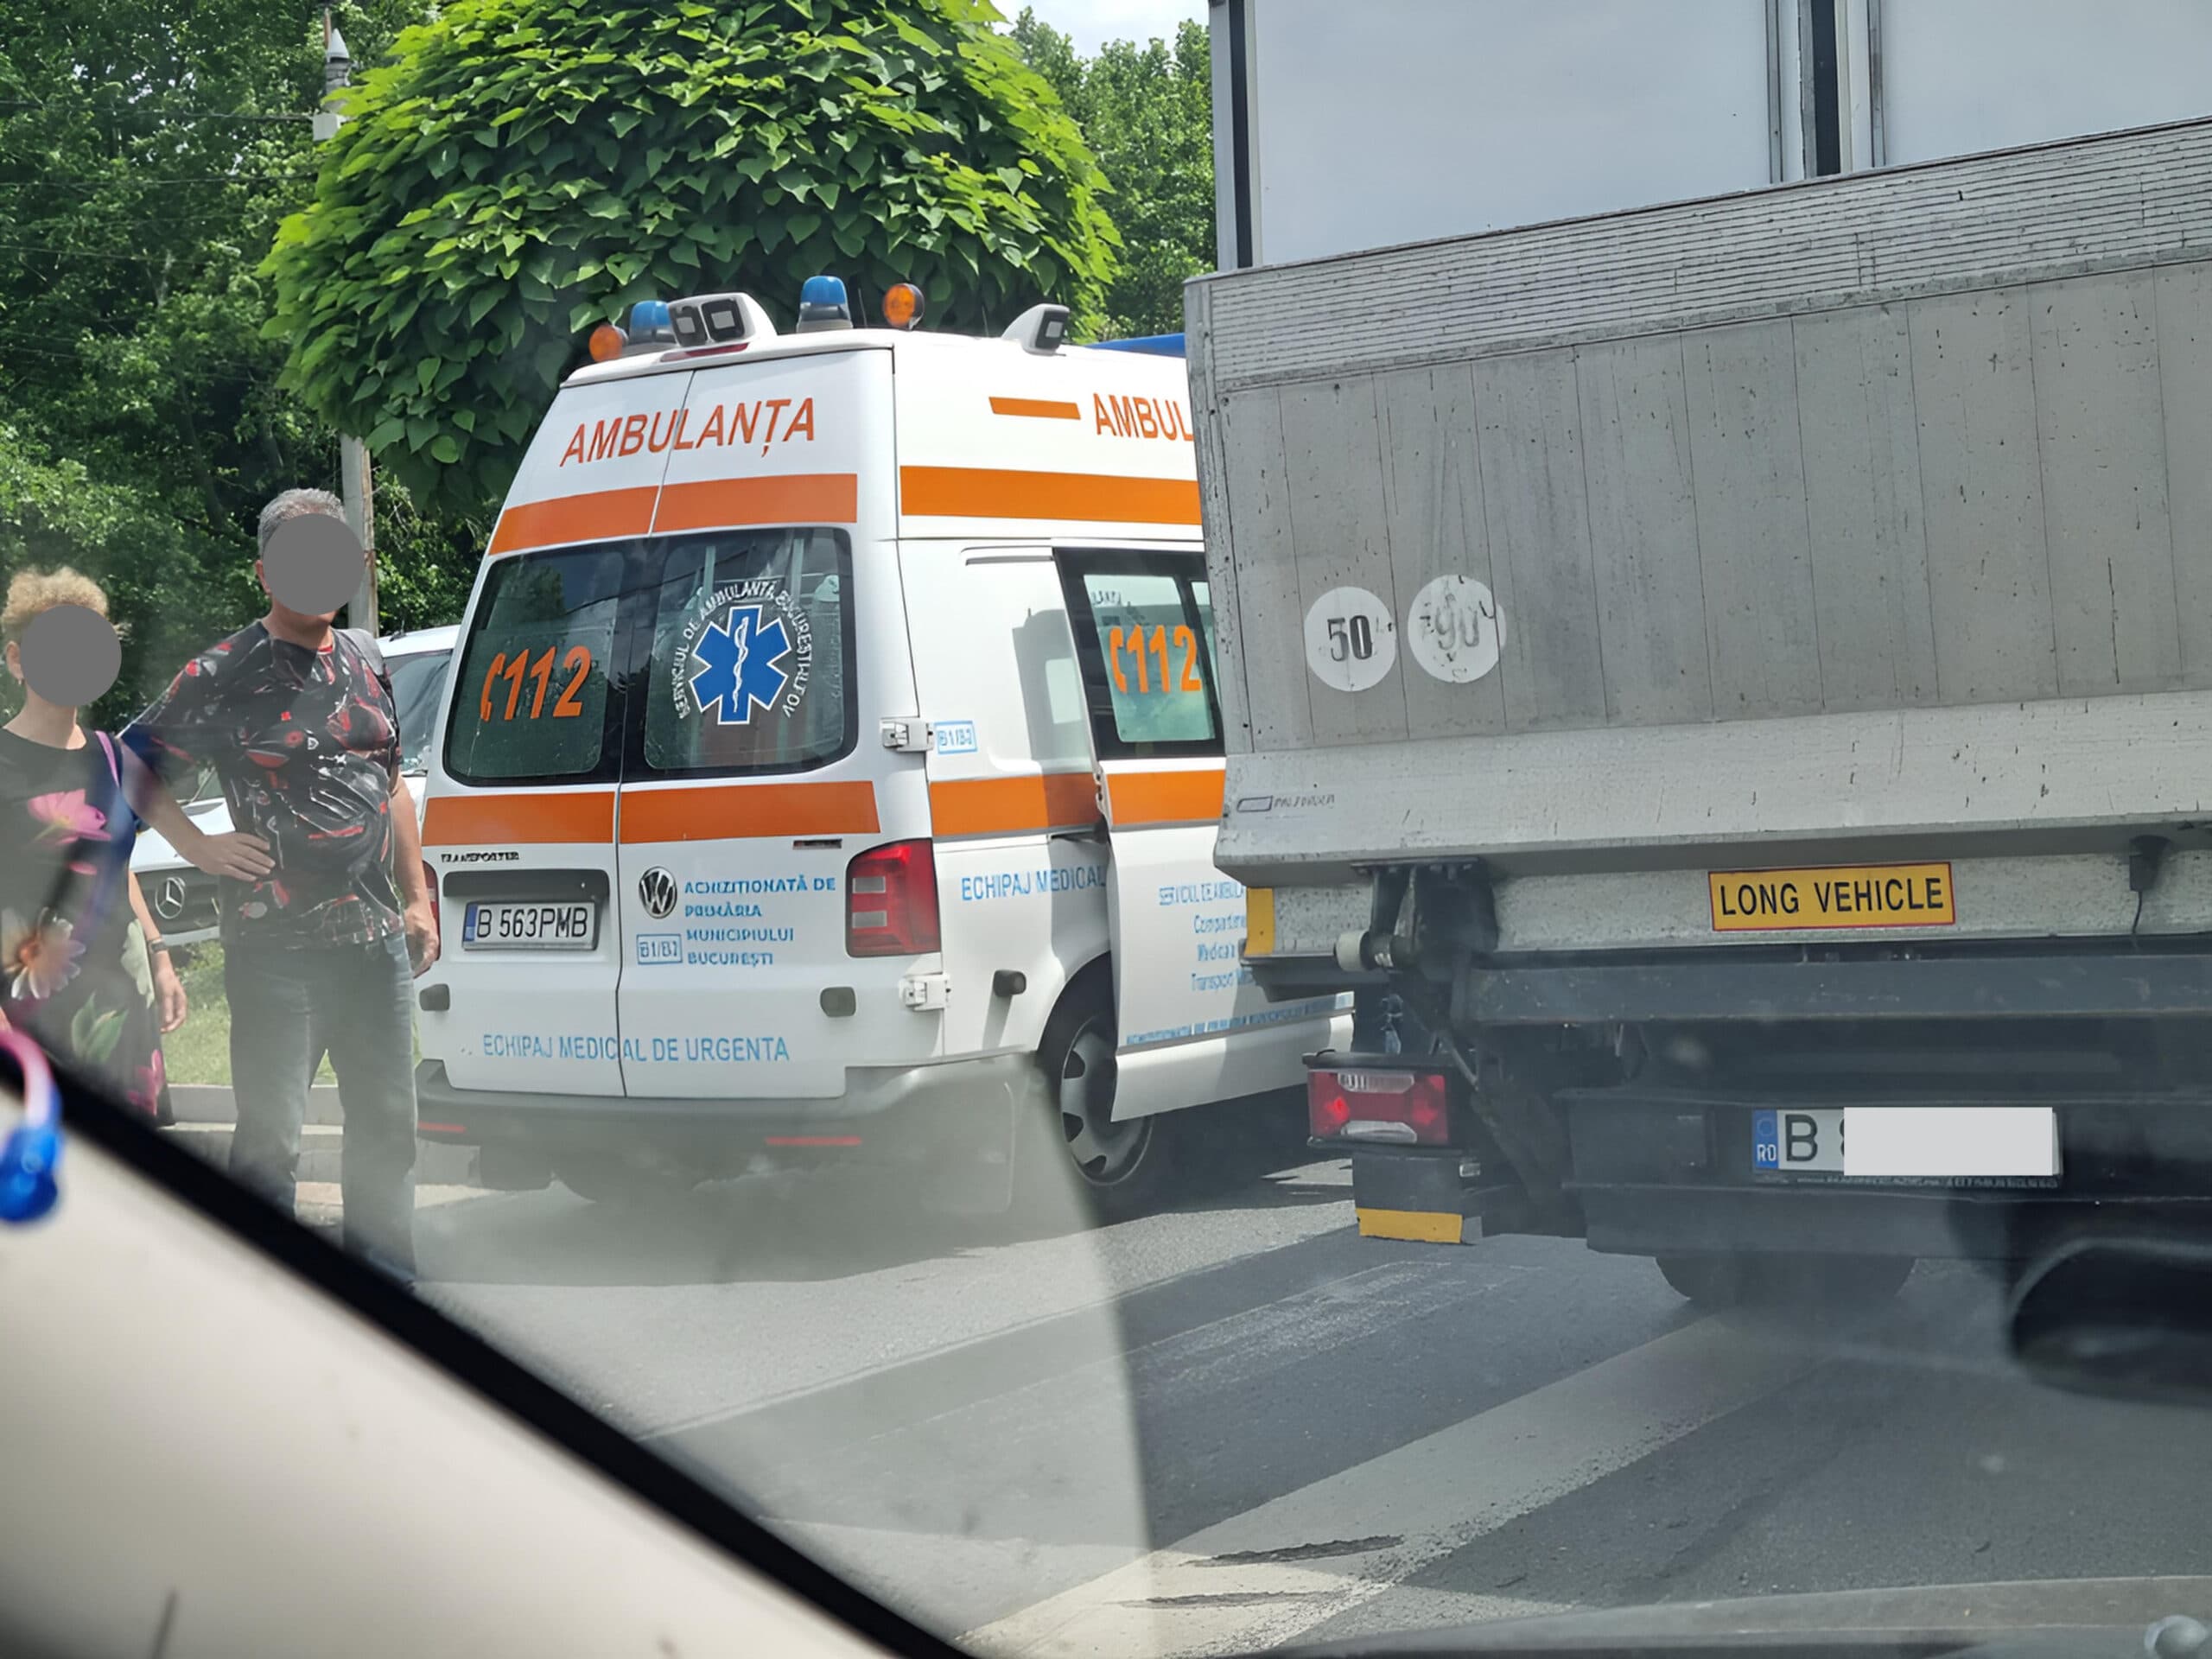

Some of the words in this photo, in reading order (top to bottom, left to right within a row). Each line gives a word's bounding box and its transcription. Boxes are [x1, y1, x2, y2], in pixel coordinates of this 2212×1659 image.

[560, 397, 816, 468] AMBULANȚA
[1326, 614, 1374, 663] 50
[1126, 624, 1203, 694] 112
[504, 645, 593, 721] 112
[812, 877, 836, 892] DE
[960, 871, 1032, 901] ECHIPAJ
[1035, 864, 1107, 893] MEDICAL
[1719, 882, 1800, 917] LONG
[1813, 875, 1944, 912] VEHICLE
[476, 908, 493, 938] B
[499, 907, 588, 938] 563PMB
[686, 927, 794, 942] MUNICIPIULUI
[483, 1033, 554, 1058] ECHIPAJ
[558, 1036, 647, 1062] MEDICAL
[652, 1038, 679, 1062] DE
[686, 1036, 791, 1063] URGENTA
[1757, 1143, 1777, 1162] RO
[1784, 1114, 1818, 1162] B
